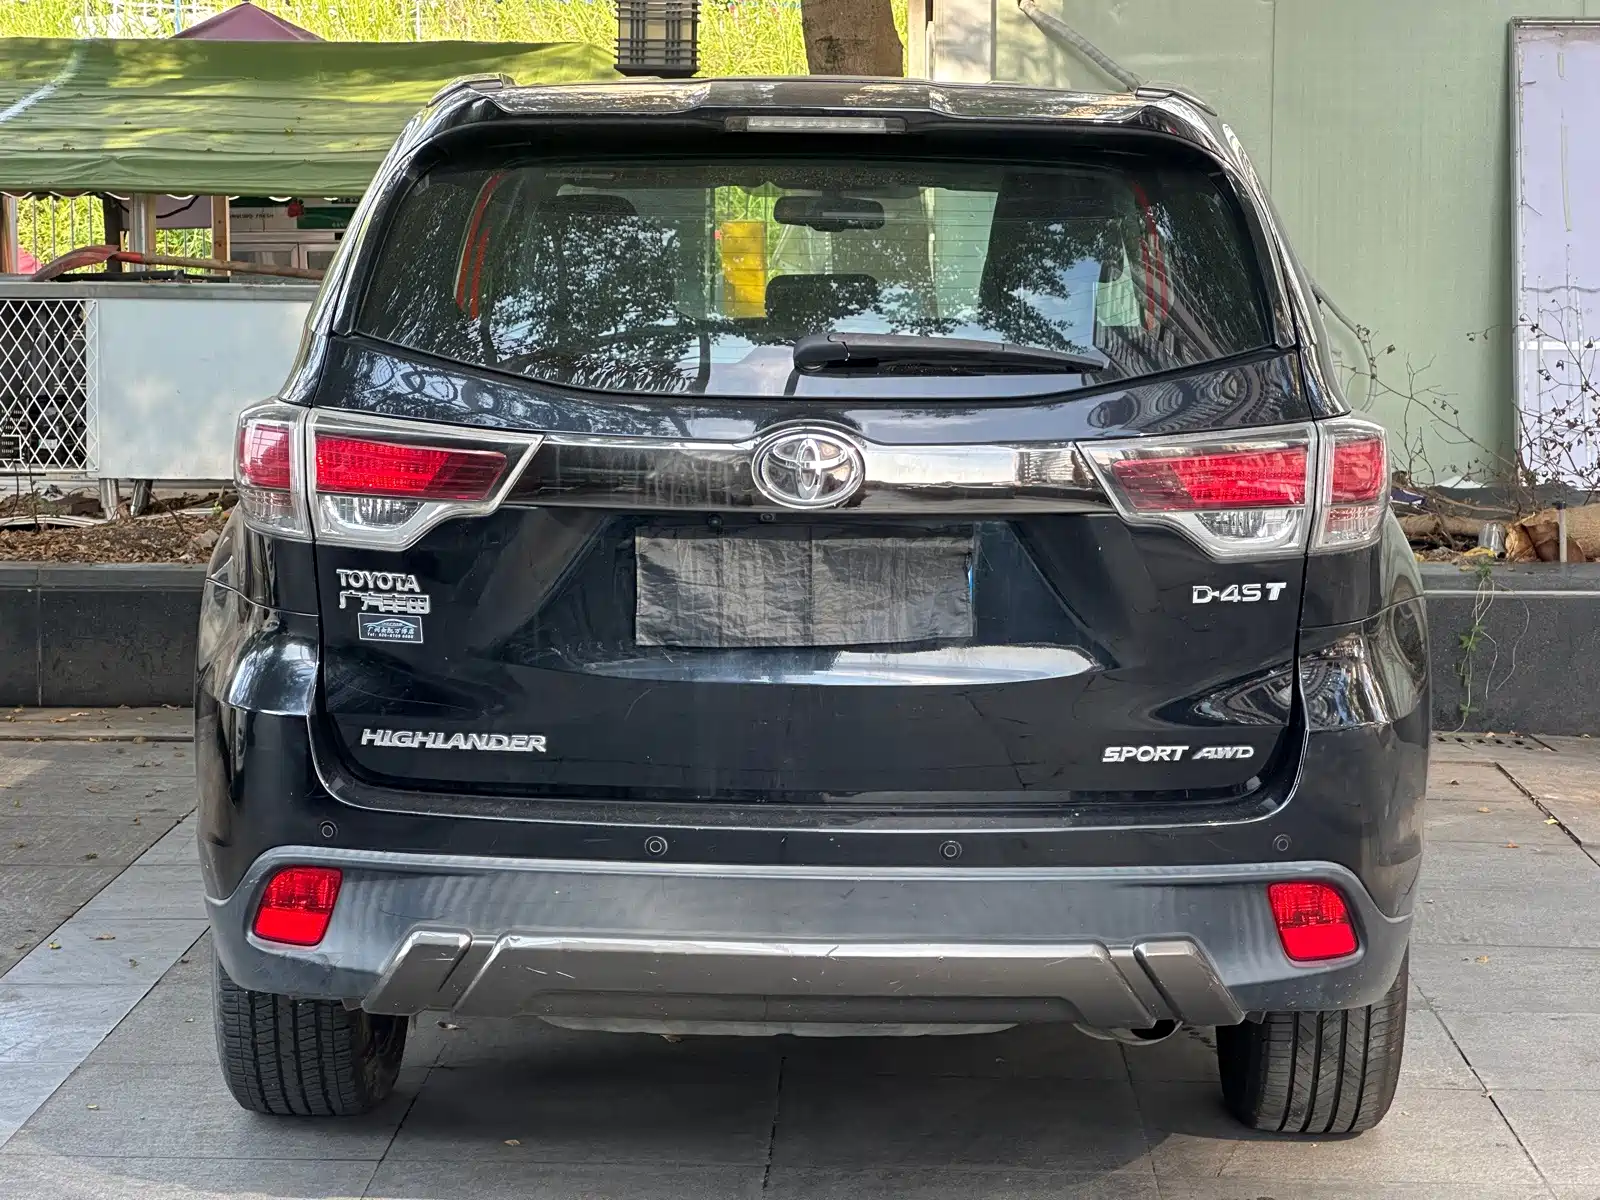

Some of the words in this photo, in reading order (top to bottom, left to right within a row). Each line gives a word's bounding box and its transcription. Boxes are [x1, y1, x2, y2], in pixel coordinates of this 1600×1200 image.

[336, 569, 420, 592] TOYOTA
[339, 590, 430, 614] 广汽丰田
[361, 728, 547, 753] HIGHLANDER
[1102, 745, 1189, 762] SPORT
[1192, 746, 1255, 760] AWD
